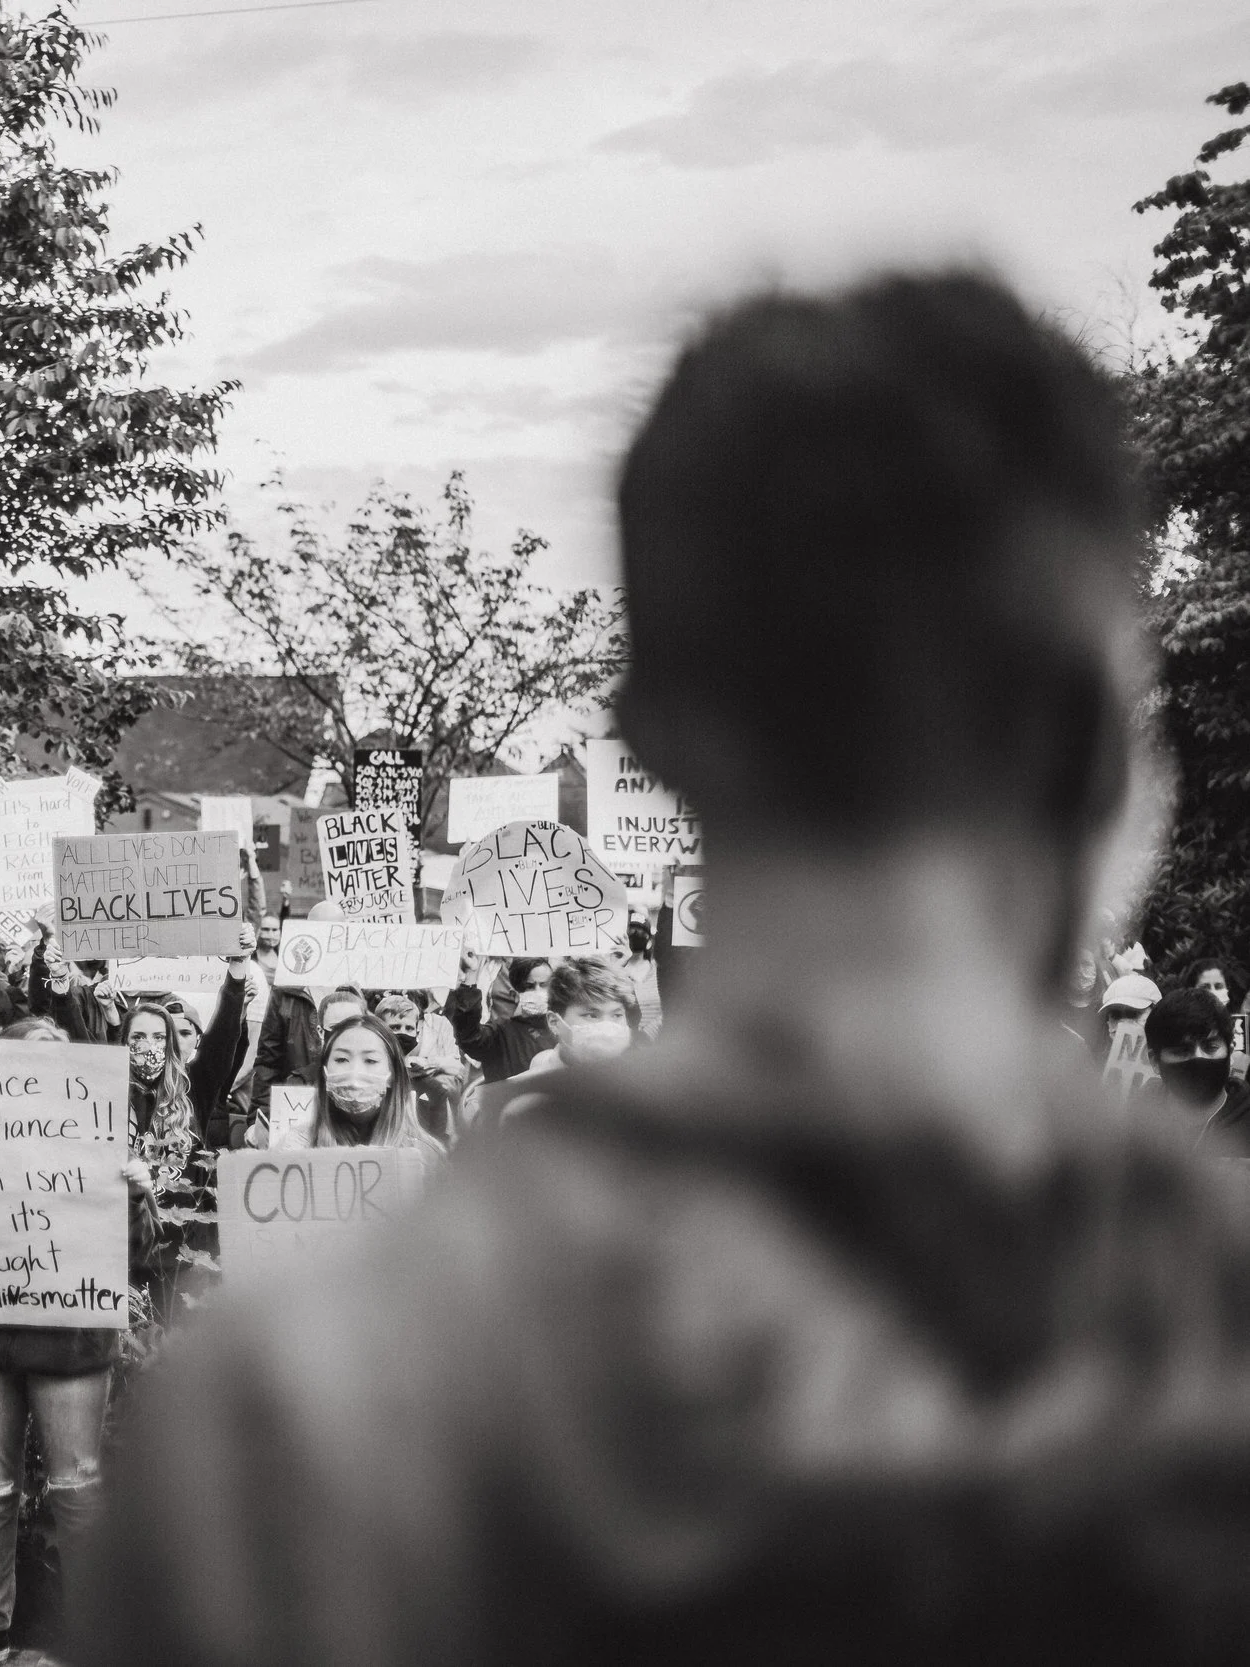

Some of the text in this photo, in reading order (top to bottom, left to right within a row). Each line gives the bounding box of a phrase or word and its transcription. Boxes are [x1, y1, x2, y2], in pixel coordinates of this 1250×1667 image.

[369, 750, 405, 765] CALL
[39, 791, 72, 813] hard
[26, 818, 40, 831] to
[325, 812, 399, 840] BLACK
[617, 816, 701, 834] INJUST
[61, 835, 231, 866] ALL LIVES DON'T
[328, 837, 399, 869] LIVES
[462, 827, 616, 882] BLACK
[602, 834, 701, 855] EVERYW
[4, 852, 53, 871] RACI
[17, 870, 43, 883] from
[59, 863, 214, 896] MATTER UNTIL
[327, 865, 405, 897] MATTER
[468, 867, 604, 909] LIVES
[565, 885, 584, 896] BLM
[60, 893, 141, 921] BLACK
[145, 886, 239, 919] LIVES
[366, 889, 406, 910] JUSTICE
[61, 925, 160, 952] MATTER
[326, 924, 398, 953] BLACK
[405, 928, 462, 950] LIVES
[454, 908, 621, 953] MATTER
[113, 973, 132, 988] No
[199, 973, 222, 984] Pea
[65, 1074, 90, 1101] is
[26, 1163, 87, 1194] isn't
[243, 1159, 392, 1224] COLOR
[11, 1200, 51, 1233] it's
